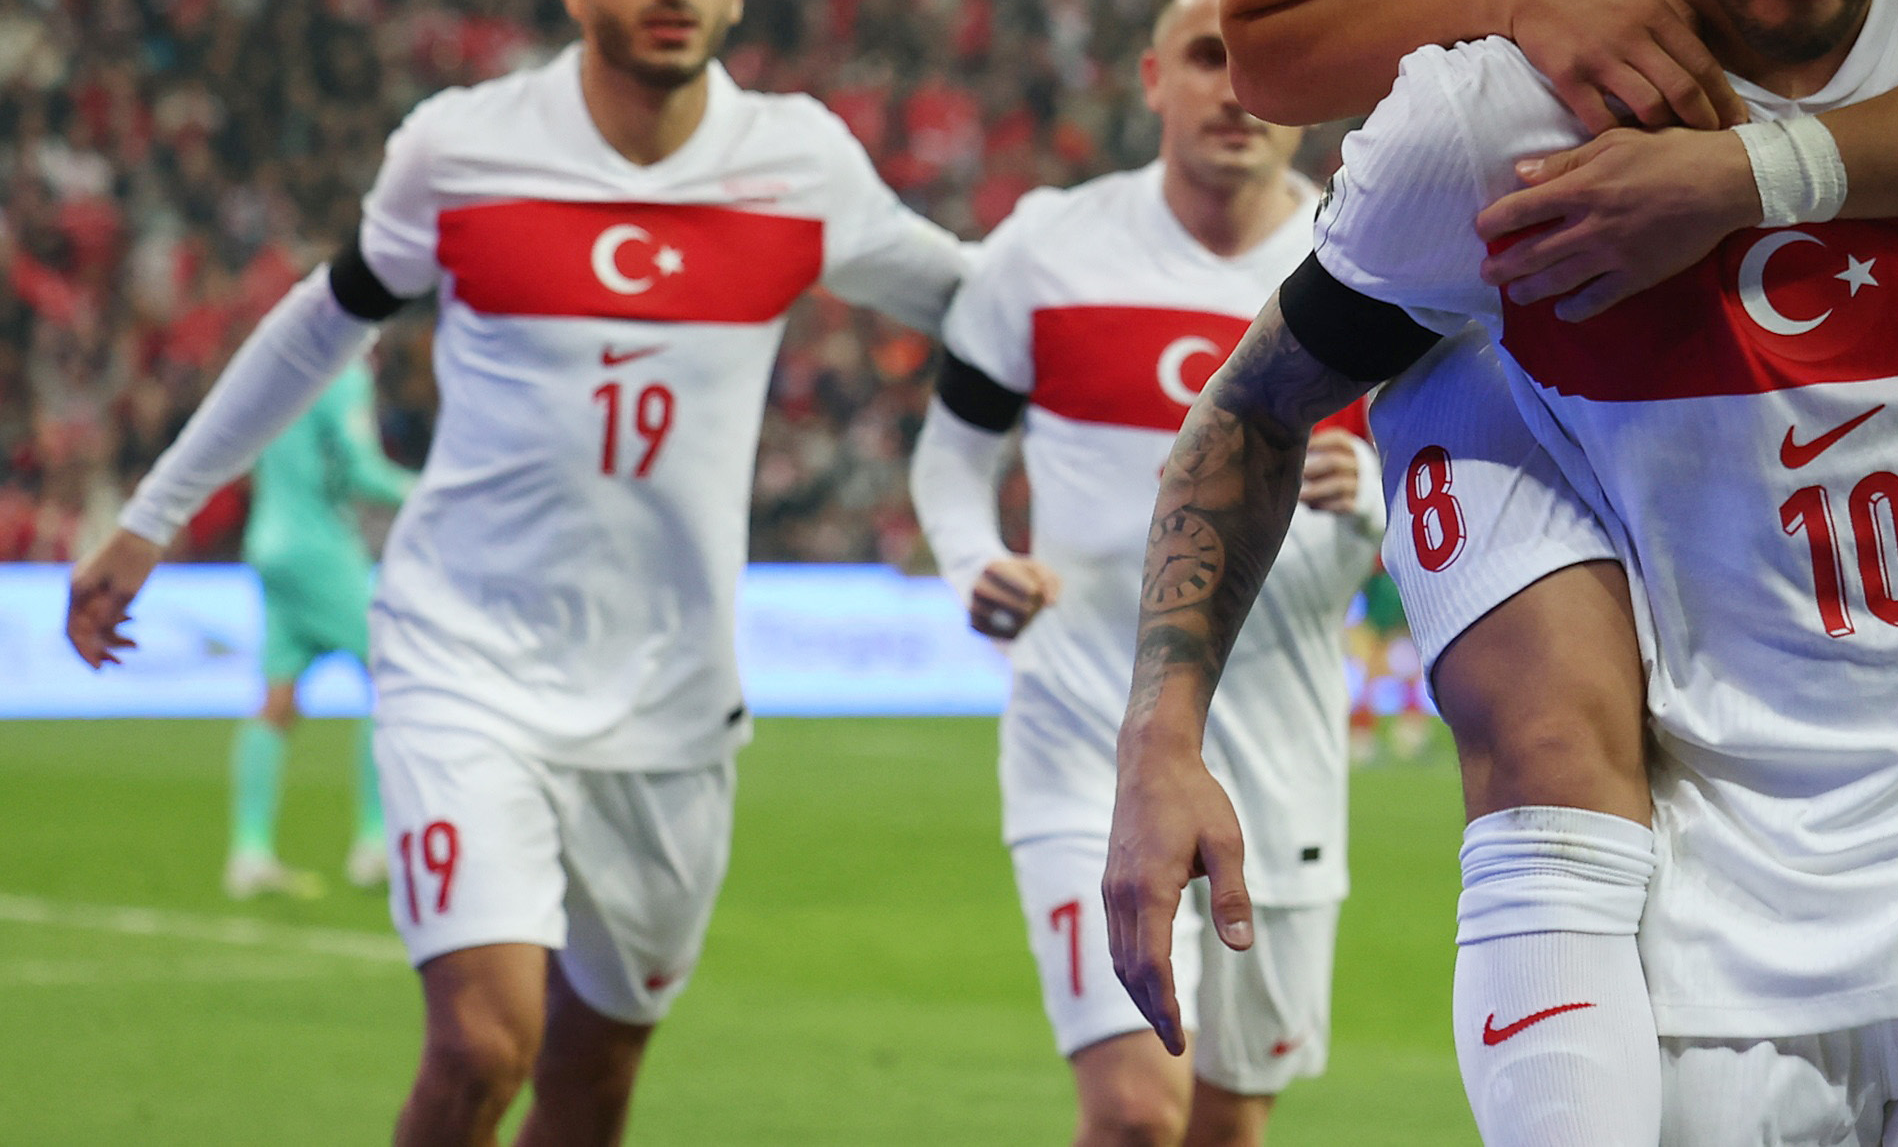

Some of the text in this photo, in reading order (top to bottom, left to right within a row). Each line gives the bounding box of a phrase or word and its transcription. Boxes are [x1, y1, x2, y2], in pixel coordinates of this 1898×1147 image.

[592, 381, 675, 477] 19
[1405, 444, 1467, 573] 8
[399, 820, 459, 925] 19
[1050, 900, 1083, 997] 7
